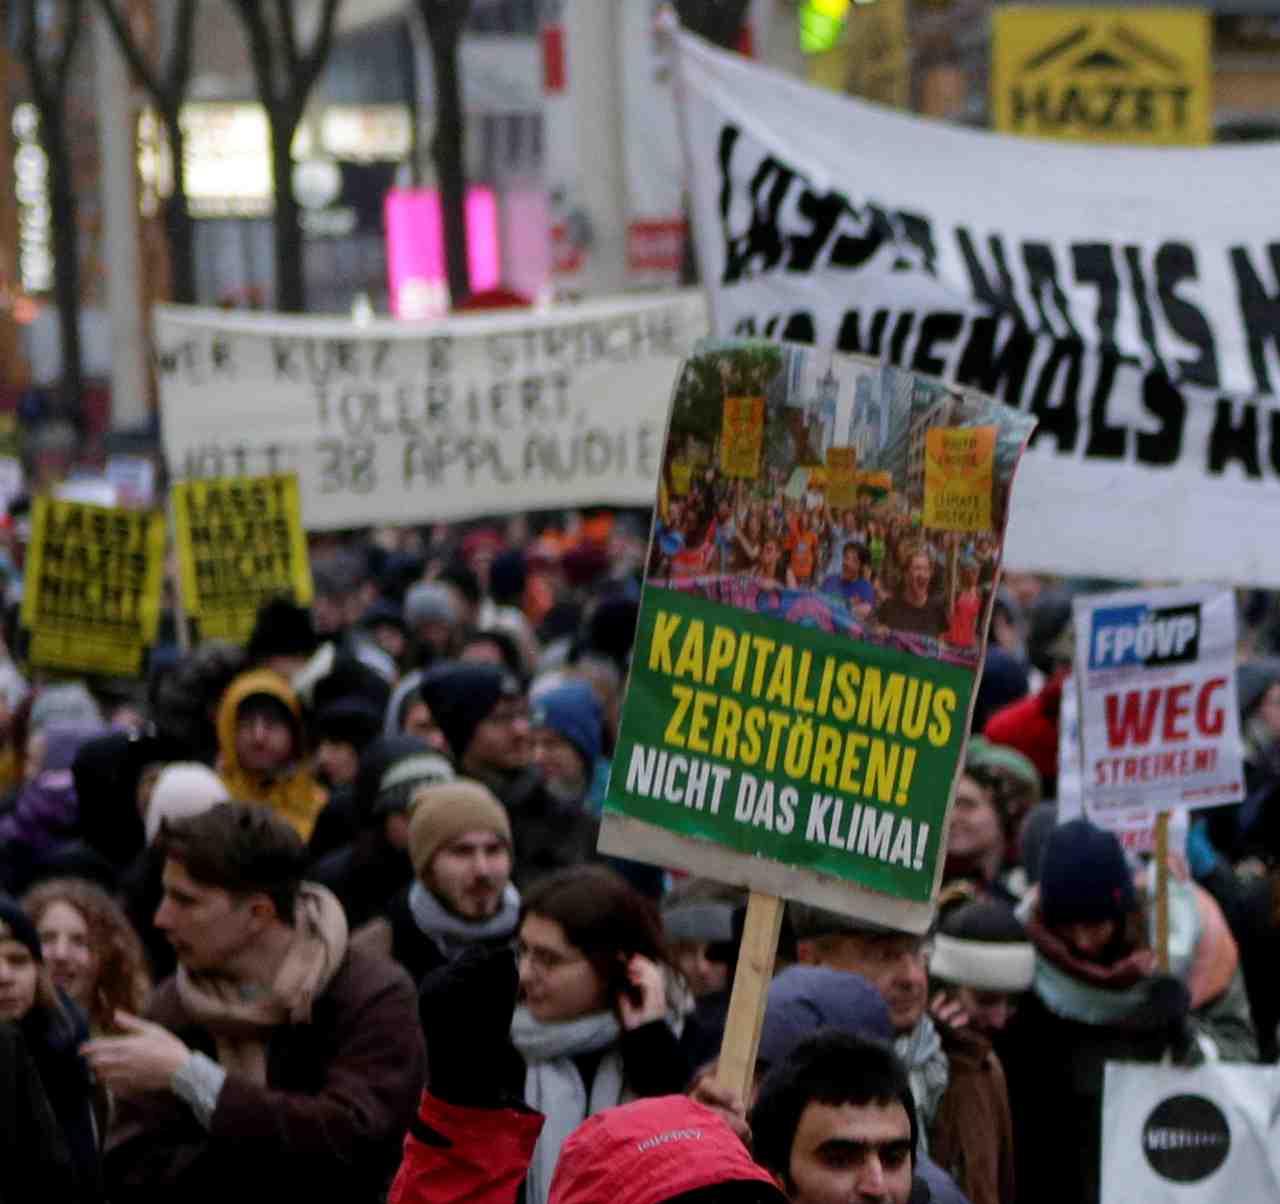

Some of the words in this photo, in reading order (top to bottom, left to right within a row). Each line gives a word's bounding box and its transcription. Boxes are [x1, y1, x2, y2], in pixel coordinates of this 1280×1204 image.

[1010, 86, 1192, 129] HAZET
[954, 226, 1221, 394] NAZIS
[402, 426, 657, 488] APPLAUDIE
[648, 609, 957, 747] KAPITALISMUS
[1104, 677, 1229, 751] WEG
[663, 687, 917, 807] ZERSTÖREN!
[624, 743, 731, 809] NICHT
[734, 771, 799, 836] DAS
[805, 792, 931, 872] KLIMA!
